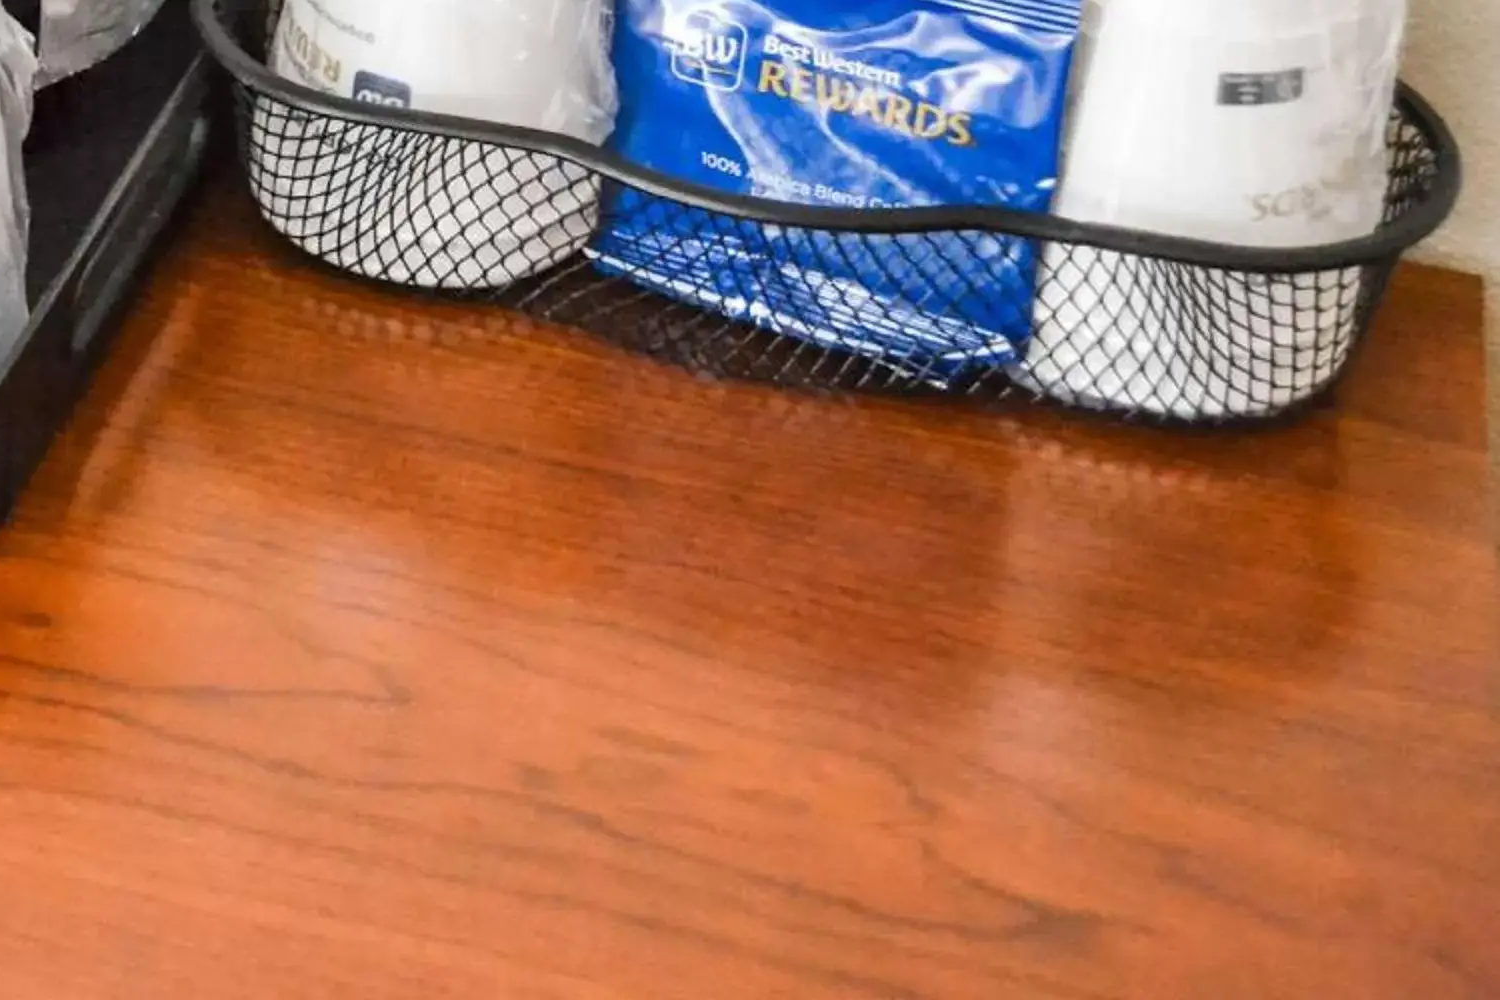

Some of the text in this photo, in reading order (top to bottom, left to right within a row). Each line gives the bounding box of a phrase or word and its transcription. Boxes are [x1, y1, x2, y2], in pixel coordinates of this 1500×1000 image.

[763, 34, 902, 86] Best Western
[757, 59, 972, 147] REWARDS
[701, 151, 742, 177] 100%
[746, 167, 811, 196] Abica
[813, 183, 864, 208] Blend
